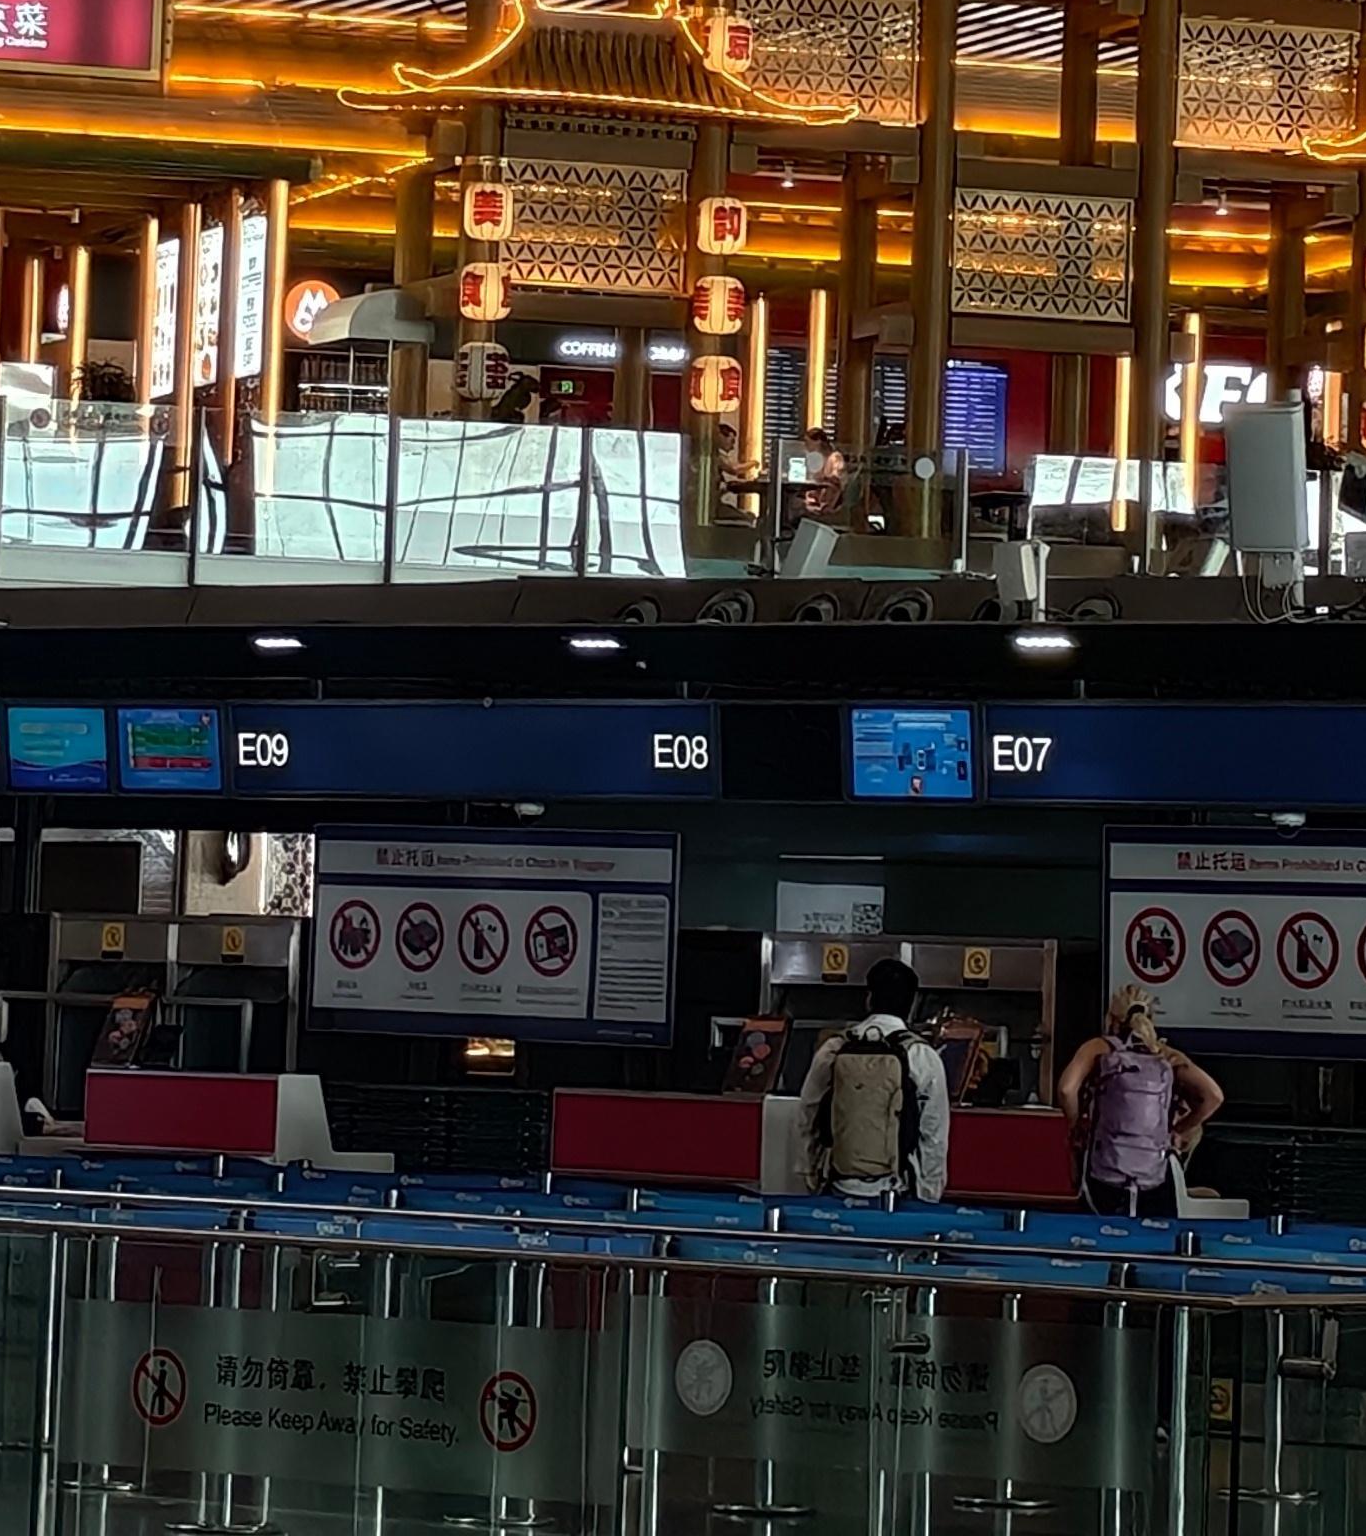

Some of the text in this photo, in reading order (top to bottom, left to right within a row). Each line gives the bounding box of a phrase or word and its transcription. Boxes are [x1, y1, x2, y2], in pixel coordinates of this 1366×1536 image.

[238, 733, 289, 767] E09
[654, 734, 709, 769] E08
[993, 735, 1052, 772] E07
[204, 1402, 262, 1428] Please
[268, 1407, 314, 1435] Keep
[371, 1414, 395, 1436] for
